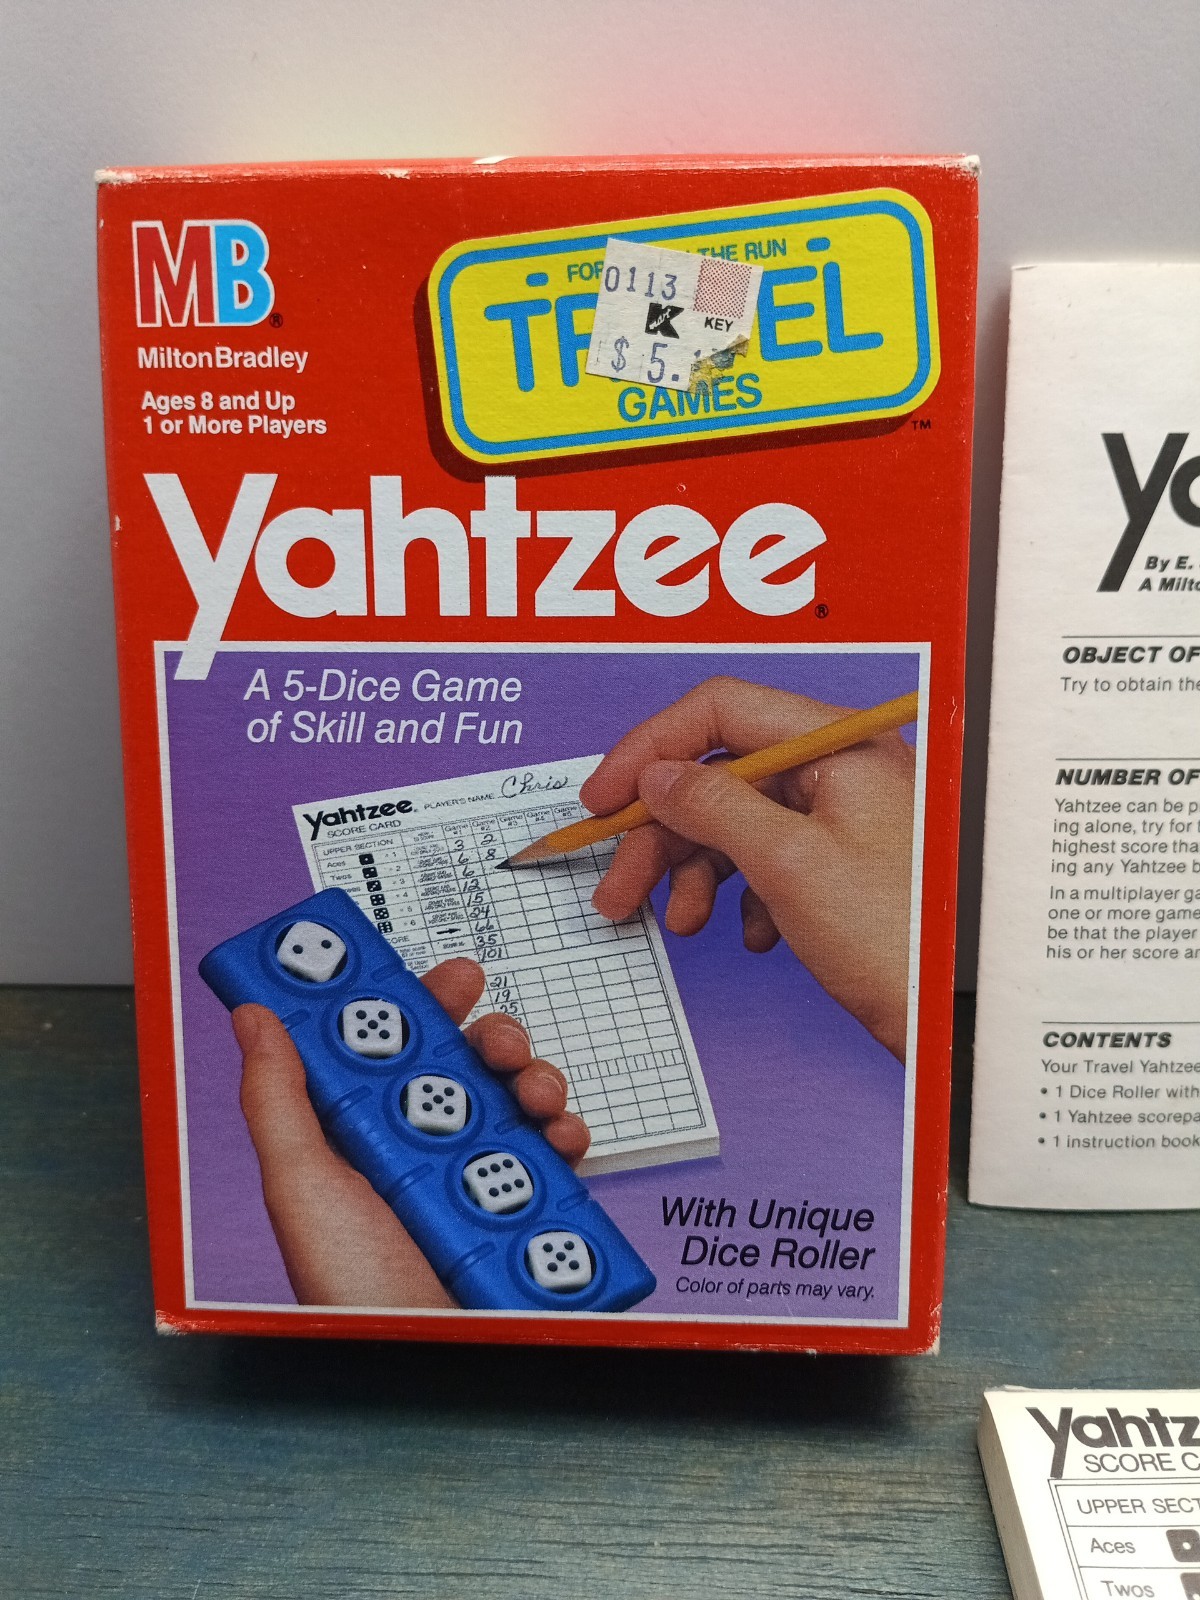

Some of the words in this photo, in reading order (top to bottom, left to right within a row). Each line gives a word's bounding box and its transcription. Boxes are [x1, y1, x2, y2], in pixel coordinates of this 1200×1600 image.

[744, 238, 787, 261] RUN
[132, 219, 275, 327] MB
[604, 266, 678, 301] 0113
[704, 316, 734, 332] KEY
[141, 391, 196, 415] Ages
[200, 393, 214, 410] 8
[219, 391, 260, 410] and
[265, 393, 296, 415] Up
[618, 373, 763, 423] GAMES
[144, 415, 153, 434] 1
[160, 419, 183, 434] or
[188, 415, 243, 434] More
[248, 415, 327, 439] Players
[1144, 555, 1170, 572] By
[1174, 556, 1193, 570] E.
[1138, 578, 1152, 592] A
[1062, 646, 1163, 663] OBJECT
[1169, 646, 1200, 663] OF
[243, 669, 271, 702] A
[282, 668, 402, 703] 5-Dice
[411, 669, 522, 703] Game
[1060, 676, 1088, 695] Try
[1093, 678, 1110, 692] to
[1117, 676, 1171, 692] obtain
[1178, 676, 1200, 692] the
[247, 711, 283, 745] of
[291, 710, 364, 745] Skill
[374, 712, 446, 745] and
[455, 713, 523, 745] Fun
[501, 772, 568, 798] Chris
[1055, 768, 1161, 786] NUMBER
[1167, 768, 1200, 786] OF
[1055, 798, 1122, 814] Yahtzee
[1126, 801, 1157, 814] can
[1163, 798, 1183, 813] be
[327, 825, 366, 838] SCORE
[369, 819, 402, 832] CARD
[1053, 819, 1079, 836] ing
[1084, 819, 1136, 835] alone,
[1142, 820, 1164, 836] try
[1169, 818, 1192, 833] for
[323, 846, 352, 856] UPPER
[354, 839, 394, 850] SECTION
[453, 840, 464, 851] 3
[485, 848, 496, 860] 8
[1052, 839, 1116, 857] highest
[1120, 841, 1168, 853] score
[1051, 859, 1077, 876] ing
[1083, 861, 1114, 876] any
[1120, 859, 1186, 873] Yahtzee
[1050, 886, 1065, 900] In
[1069, 889, 1079, 900] a
[1084, 886, 1180, 903] multiplayer
[1048, 908, 1080, 920] one
[1085, 908, 1102, 920] or
[1107, 908, 1150, 920] more
[1155, 908, 1200, 923] game
[1047, 926, 1068, 939] be
[1073, 926, 1107, 939] that
[1113, 926, 1140, 939] the
[1145, 926, 1197, 942] player
[1046, 946, 1071, 959] his
[1077, 947, 1094, 959] or
[1100, 946, 1126, 959] her
[1132, 947, 1178, 959] score
[495, 989, 511, 1002] 19
[1042, 1031, 1172, 1048] CONTENTS
[1041, 1059, 1078, 1073] Your
[1083, 1059, 1133, 1073] Travel
[1139, 1059, 1200, 1073] Yahtzee
[1055, 1085, 1062, 1097] 1
[1069, 1085, 1106, 1098] Dice
[1112, 1085, 1160, 1099] Roller
[1166, 1085, 1200, 1098] with
[1054, 1109, 1061, 1123] 1
[1068, 1109, 1132, 1123] Yahtzee
[1052, 1135, 1060, 1148] 1
[1066, 1134, 1155, 1148] instruction
[1161, 1134, 1200, 1148] book
[661, 1196, 737, 1228] With
[748, 1198, 875, 1238] Unique
[680, 1235, 760, 1267] Dice
[770, 1238, 876, 1270] Roller
[676, 1276, 724, 1294] Color
[727, 1278, 745, 1294] of
[746, 1280, 791, 1298] parts
[795, 1283, 833, 1300] may
[837, 1285, 875, 1301] vary.
[1083, 1452, 1176, 1473] SCORE
[1077, 1498, 1147, 1514] UPPER
[1090, 1537, 1136, 1554] Aces
[1100, 1580, 1155, 1598] Twos
